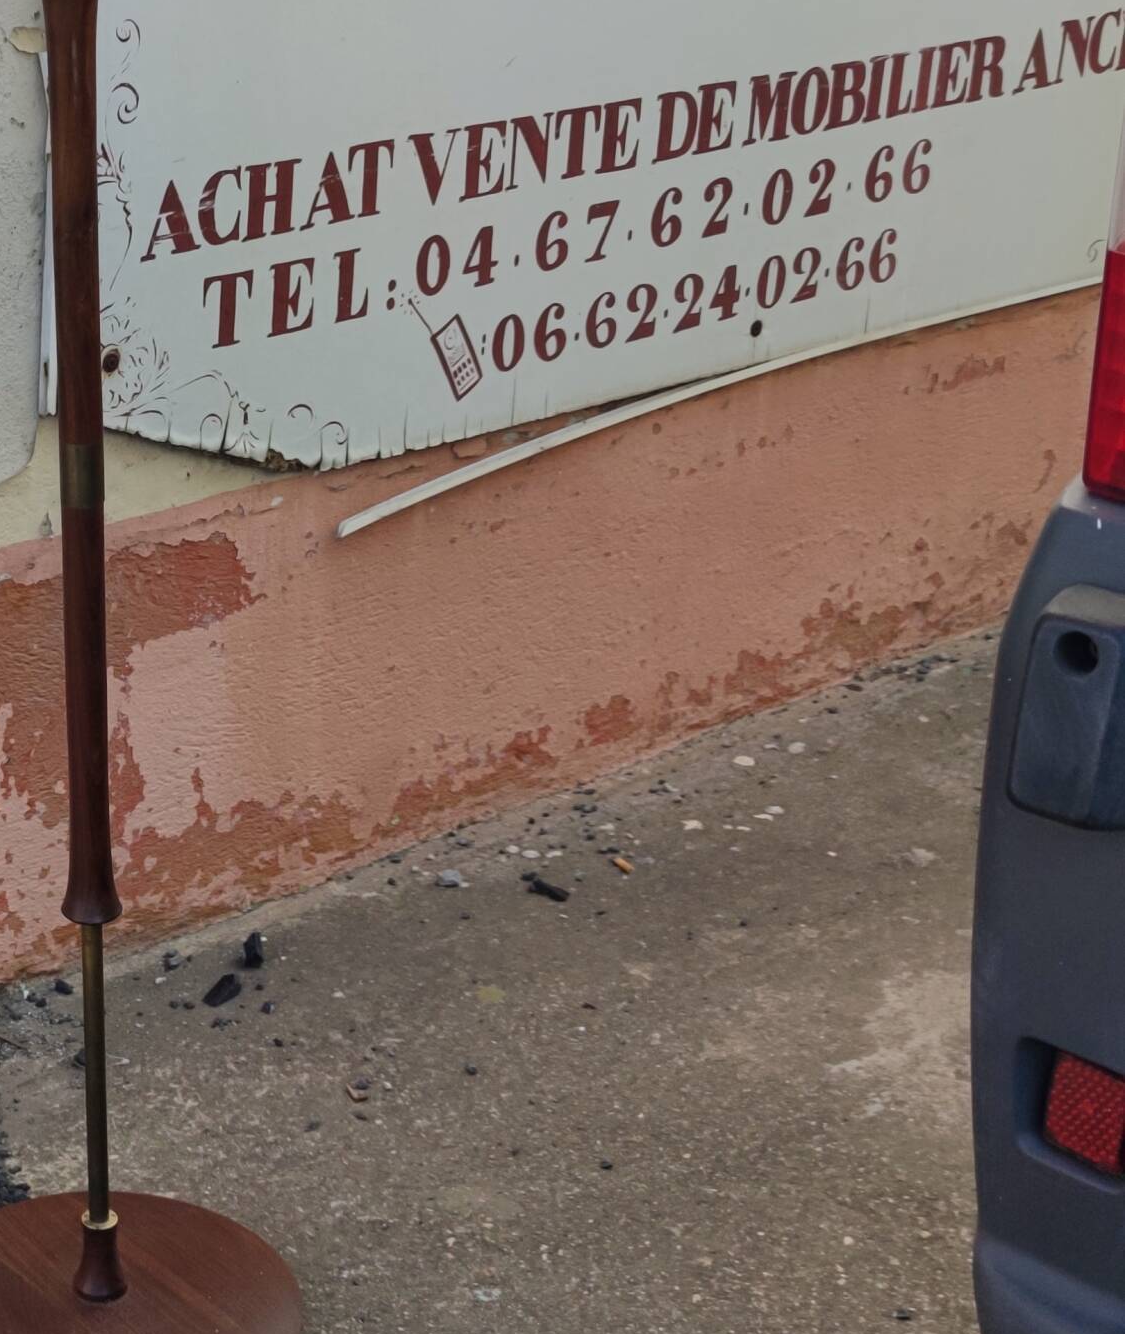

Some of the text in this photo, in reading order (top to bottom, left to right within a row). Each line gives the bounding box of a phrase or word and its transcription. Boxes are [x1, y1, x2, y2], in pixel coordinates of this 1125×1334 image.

[140, 139, 395, 263] ACHAT
[406, 97, 642, 206] VENTE
[652, 80, 737, 166] DE
[741, 35, 1006, 147] MOBILIER
